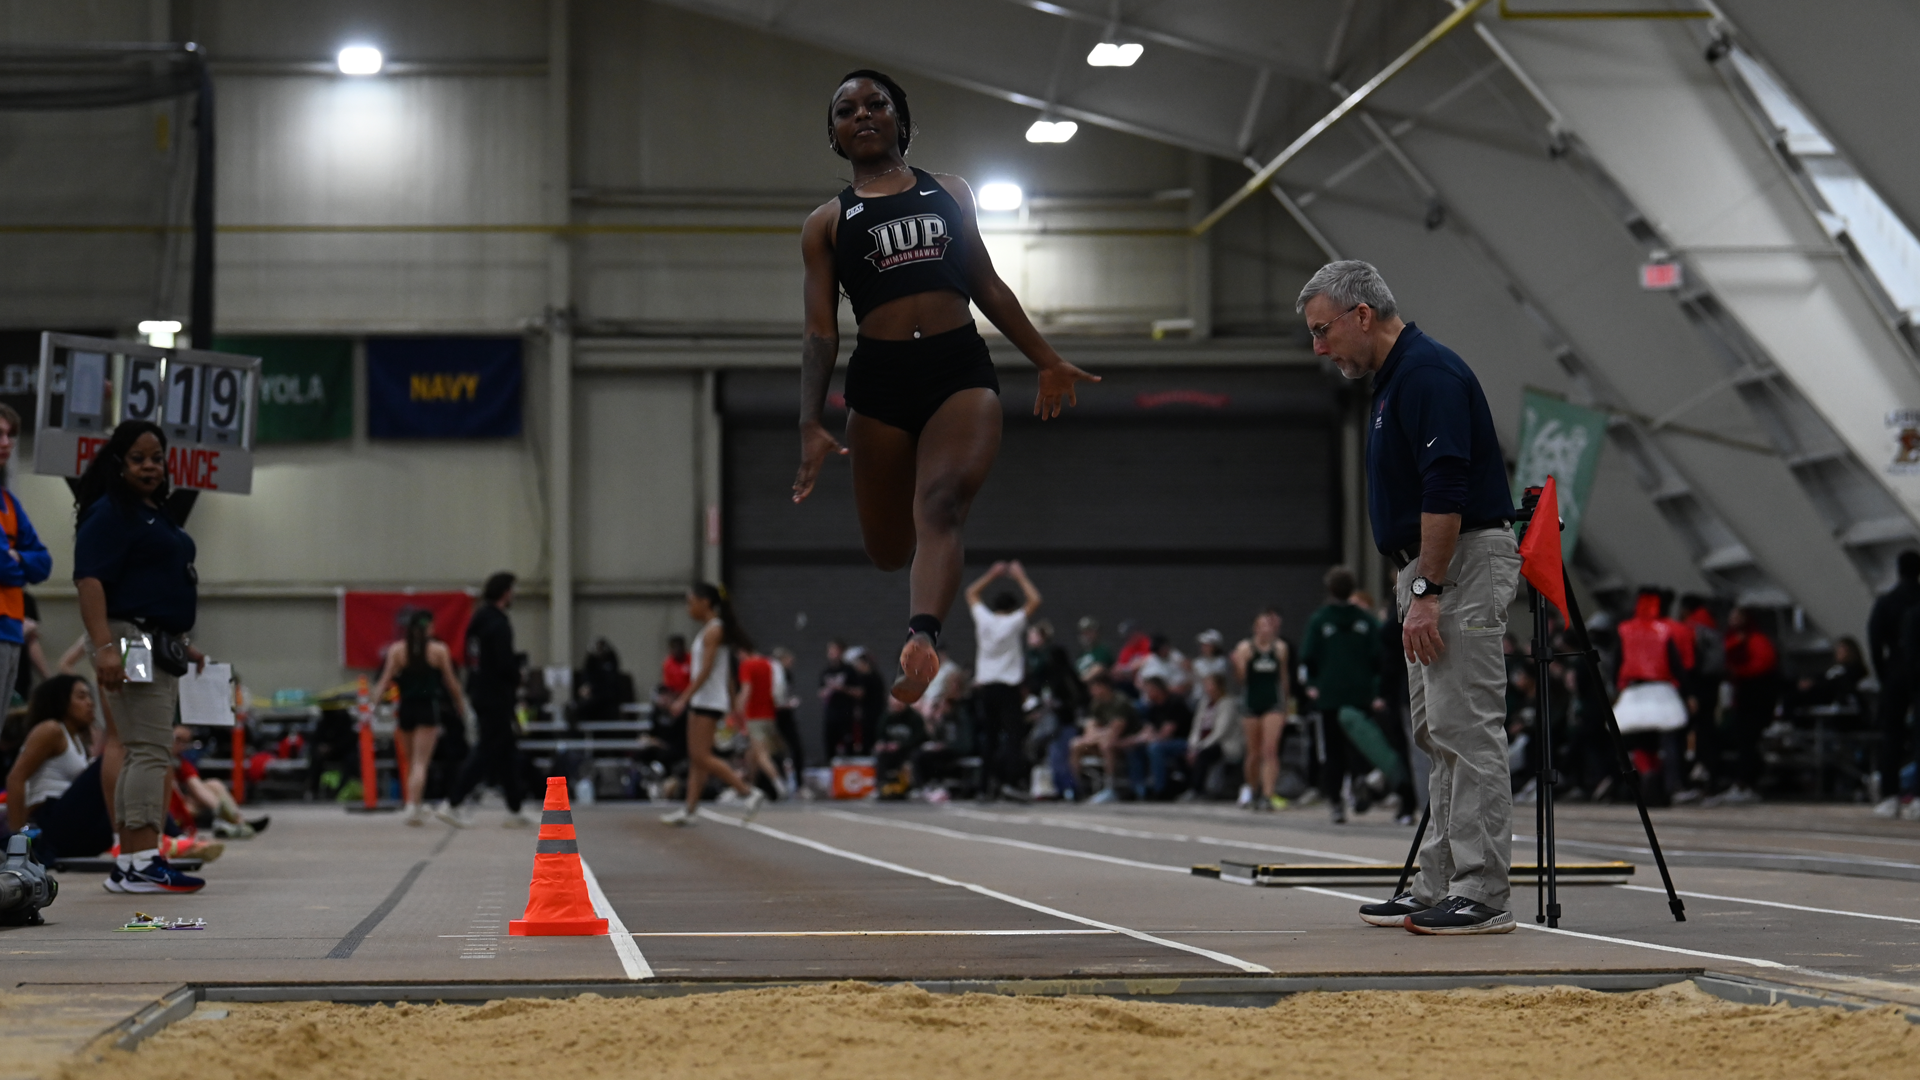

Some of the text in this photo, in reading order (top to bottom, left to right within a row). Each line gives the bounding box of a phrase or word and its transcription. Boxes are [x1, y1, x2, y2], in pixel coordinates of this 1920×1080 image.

[875, 217, 944, 257] IUP
[881, 248, 939, 267] CRIMSON HAWKS
[258, 374, 326, 406] YOLA
[410, 372, 480, 402] NAVY
